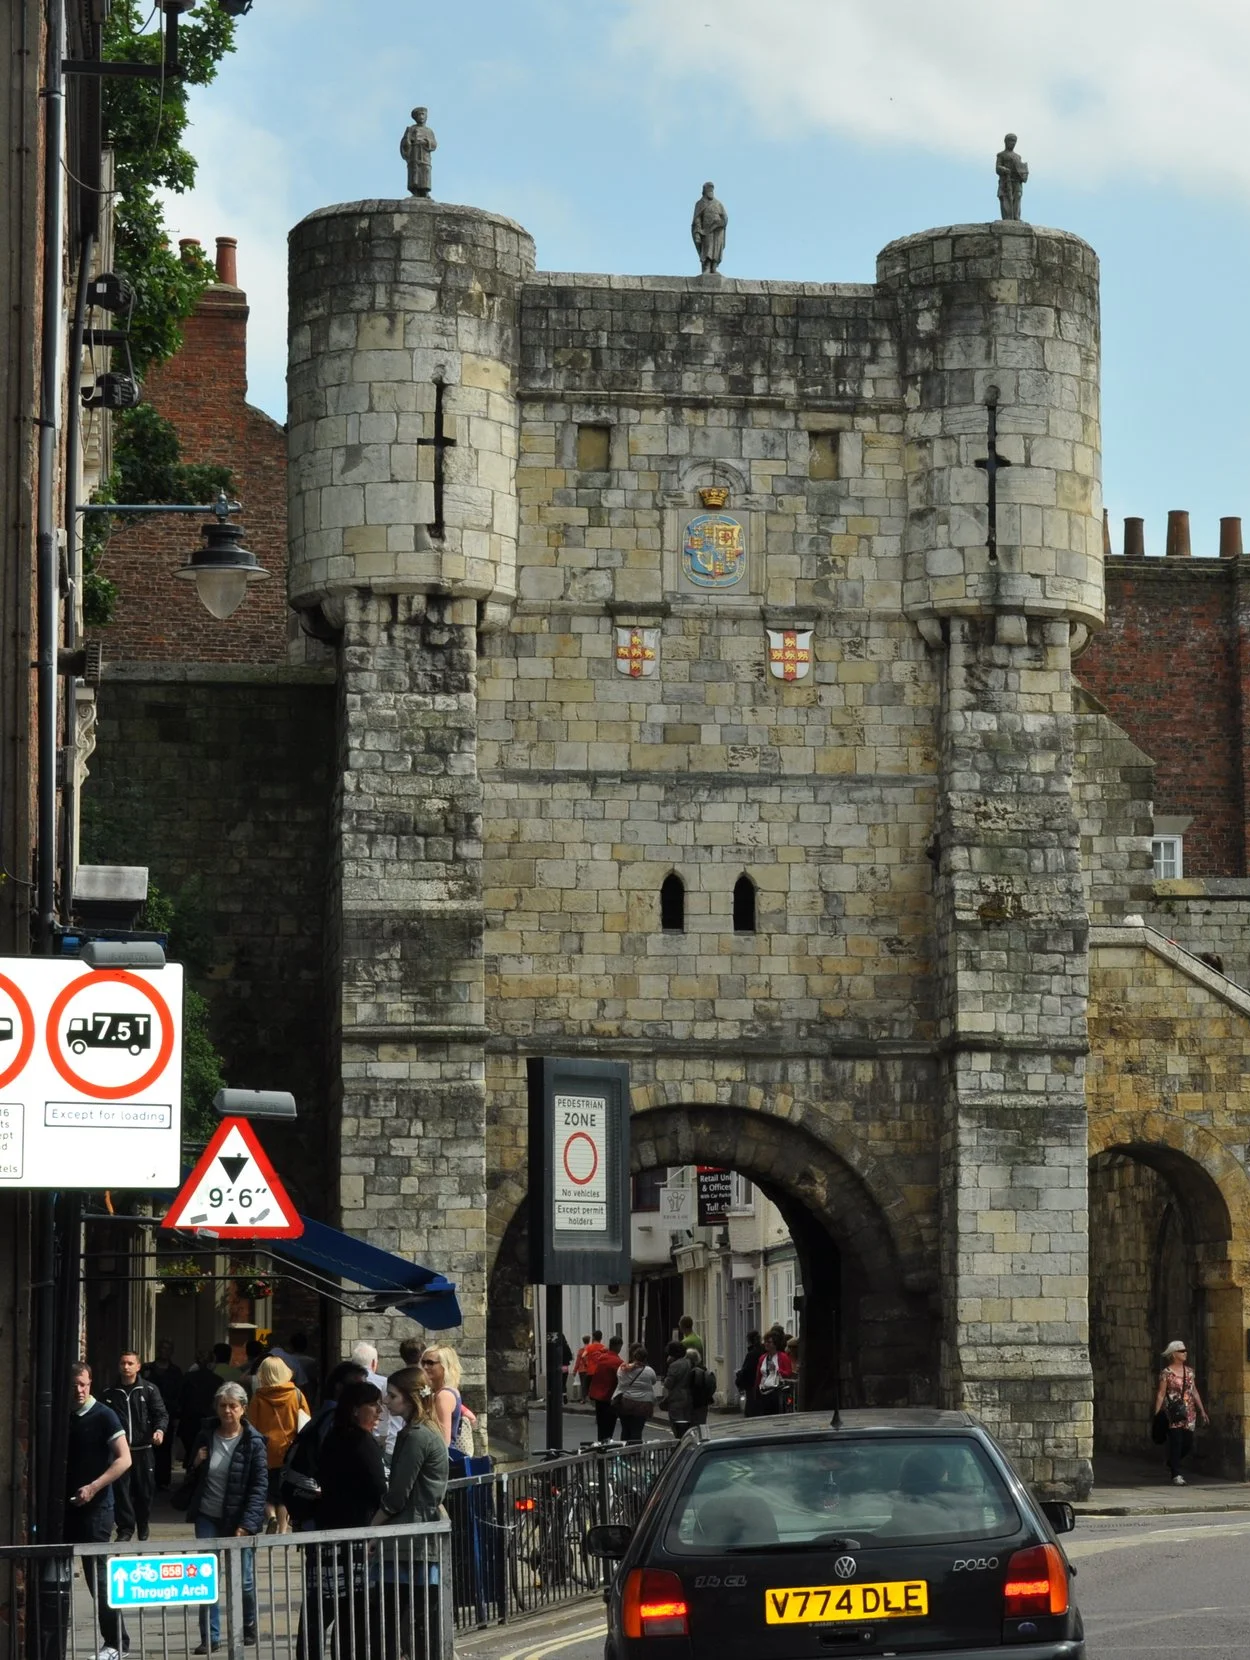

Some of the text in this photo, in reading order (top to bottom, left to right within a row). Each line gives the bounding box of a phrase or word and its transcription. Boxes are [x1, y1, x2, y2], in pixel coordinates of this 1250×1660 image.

[557, 1098, 603, 1109] PEDESTRIAN
[52, 1108, 165, 1123] Except for loading
[564, 1112, 596, 1127] ZONE
[700, 1173, 732, 1182] Retail Uni
[561, 1188, 600, 1198] No vehicles
[702, 1184, 708, 1192] &
[557, 1204, 604, 1216] Except permit
[568, 1217, 593, 1226] holders
[162, 1563, 182, 1577] 658
[953, 1557, 999, 1572] POLO
[130, 1584, 208, 1600] Through Arch
[771, 1584, 923, 1619] V774 DLE
